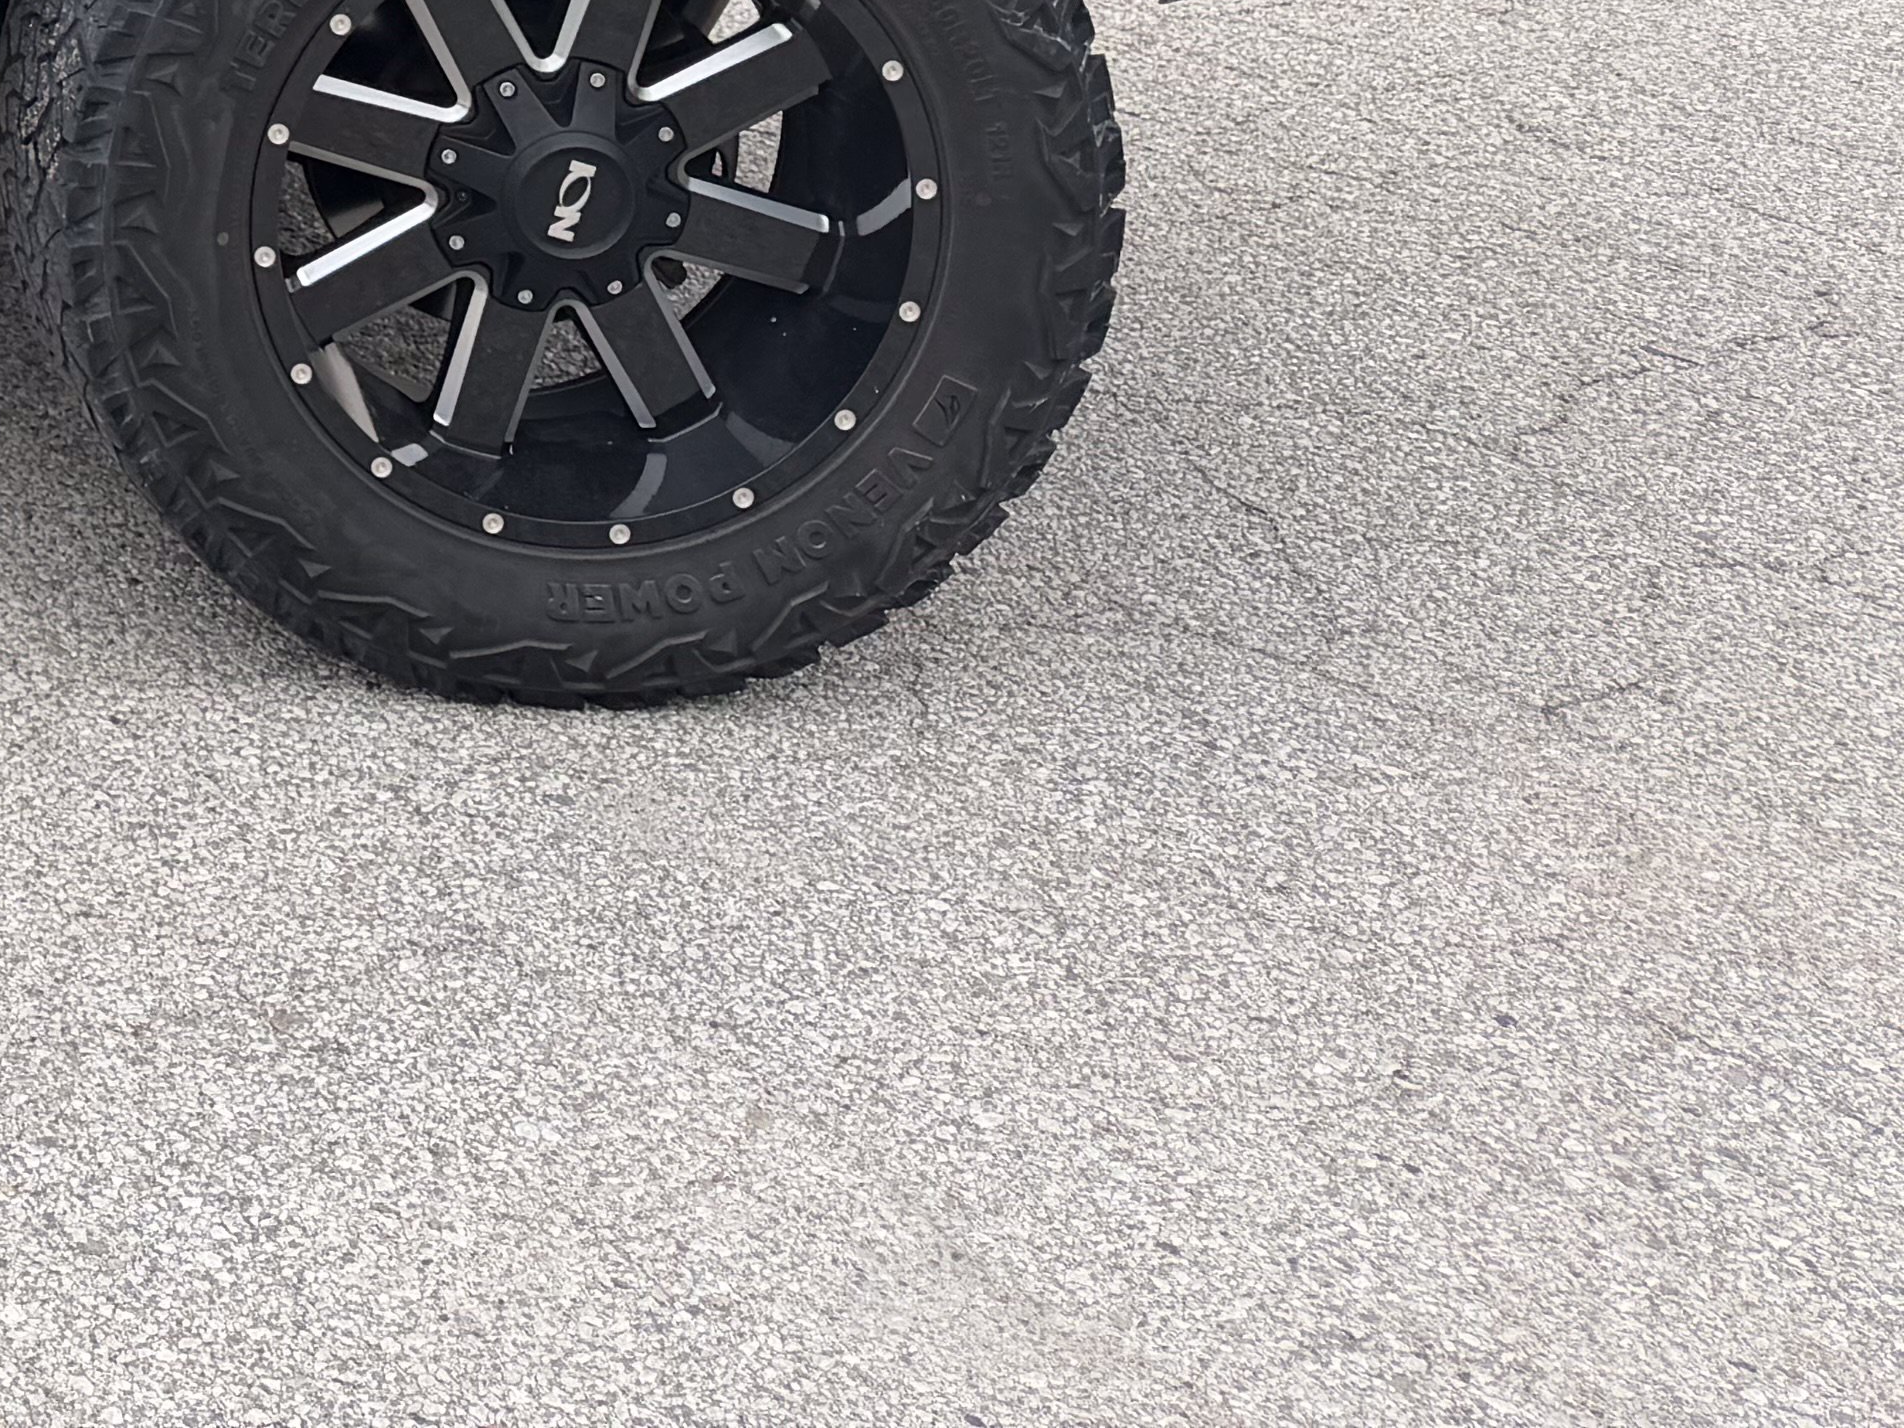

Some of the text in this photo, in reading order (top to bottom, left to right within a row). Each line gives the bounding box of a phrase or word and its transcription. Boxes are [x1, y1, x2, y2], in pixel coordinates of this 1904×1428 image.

[546, 158, 598, 243] ION
[545, 444, 935, 623] VENOM POWER
